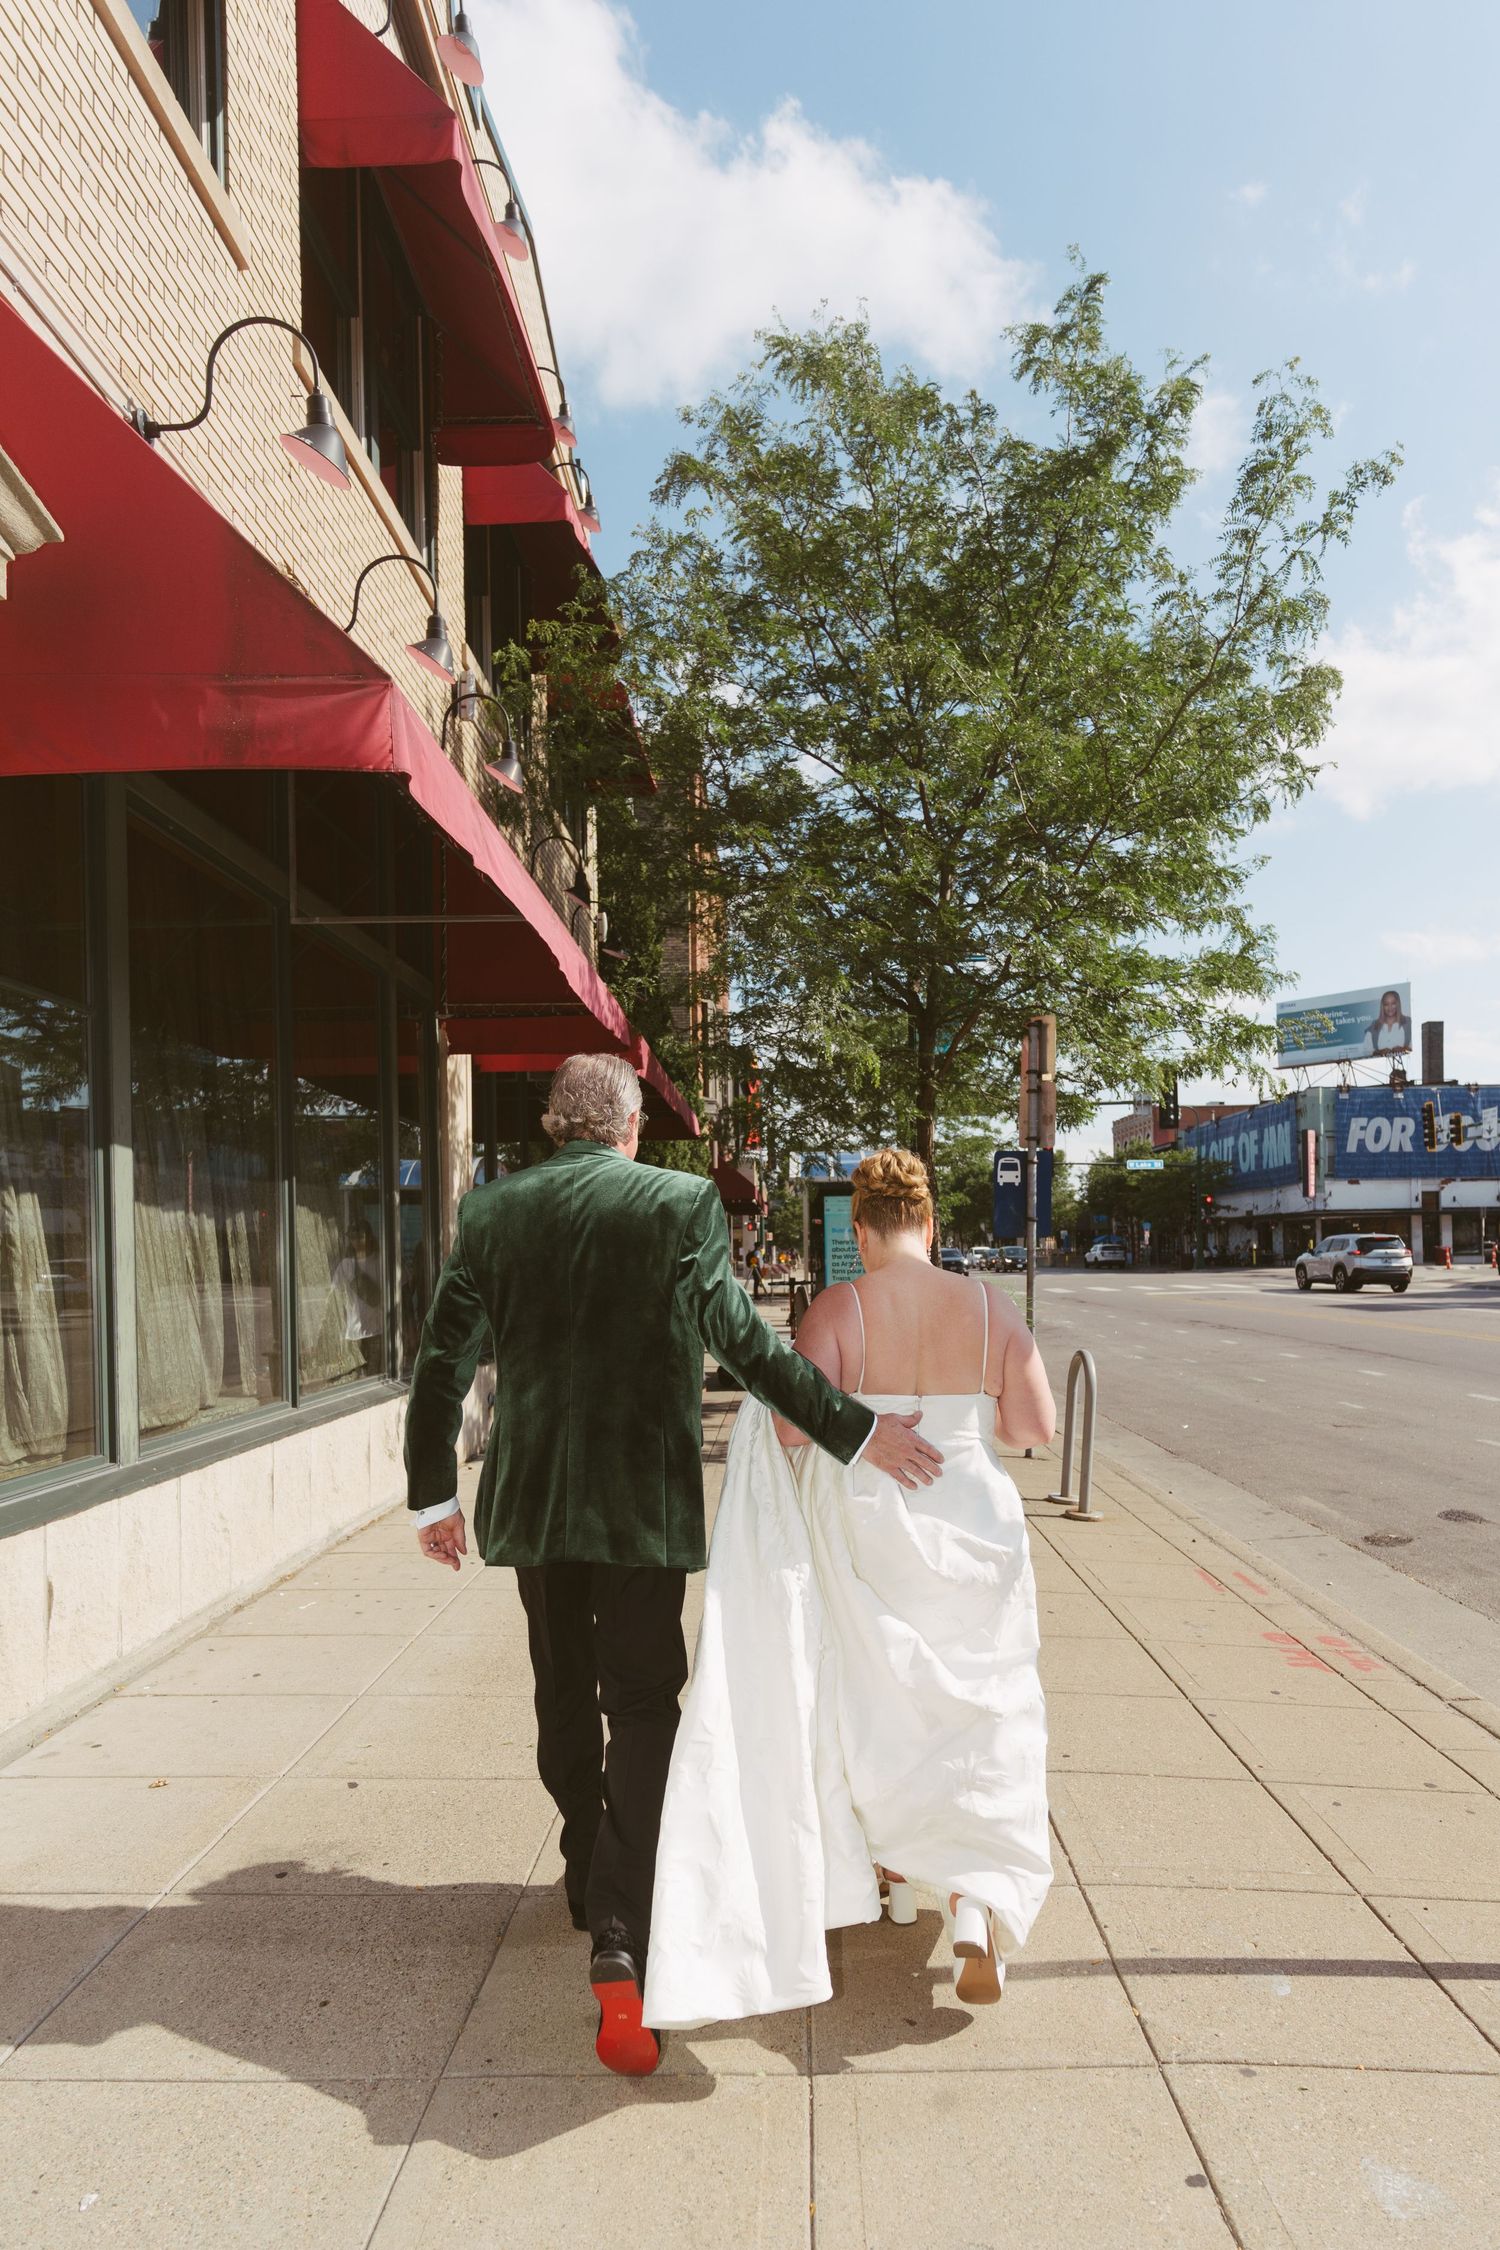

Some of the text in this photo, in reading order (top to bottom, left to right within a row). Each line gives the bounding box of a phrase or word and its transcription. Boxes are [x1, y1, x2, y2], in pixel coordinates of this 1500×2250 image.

[1335, 1016, 1356, 1026] takes
[1346, 1117, 1415, 1153] FOR
[1238, 1129, 1258, 1173] OF
[1136, 1161, 1152, 1169] Lake
